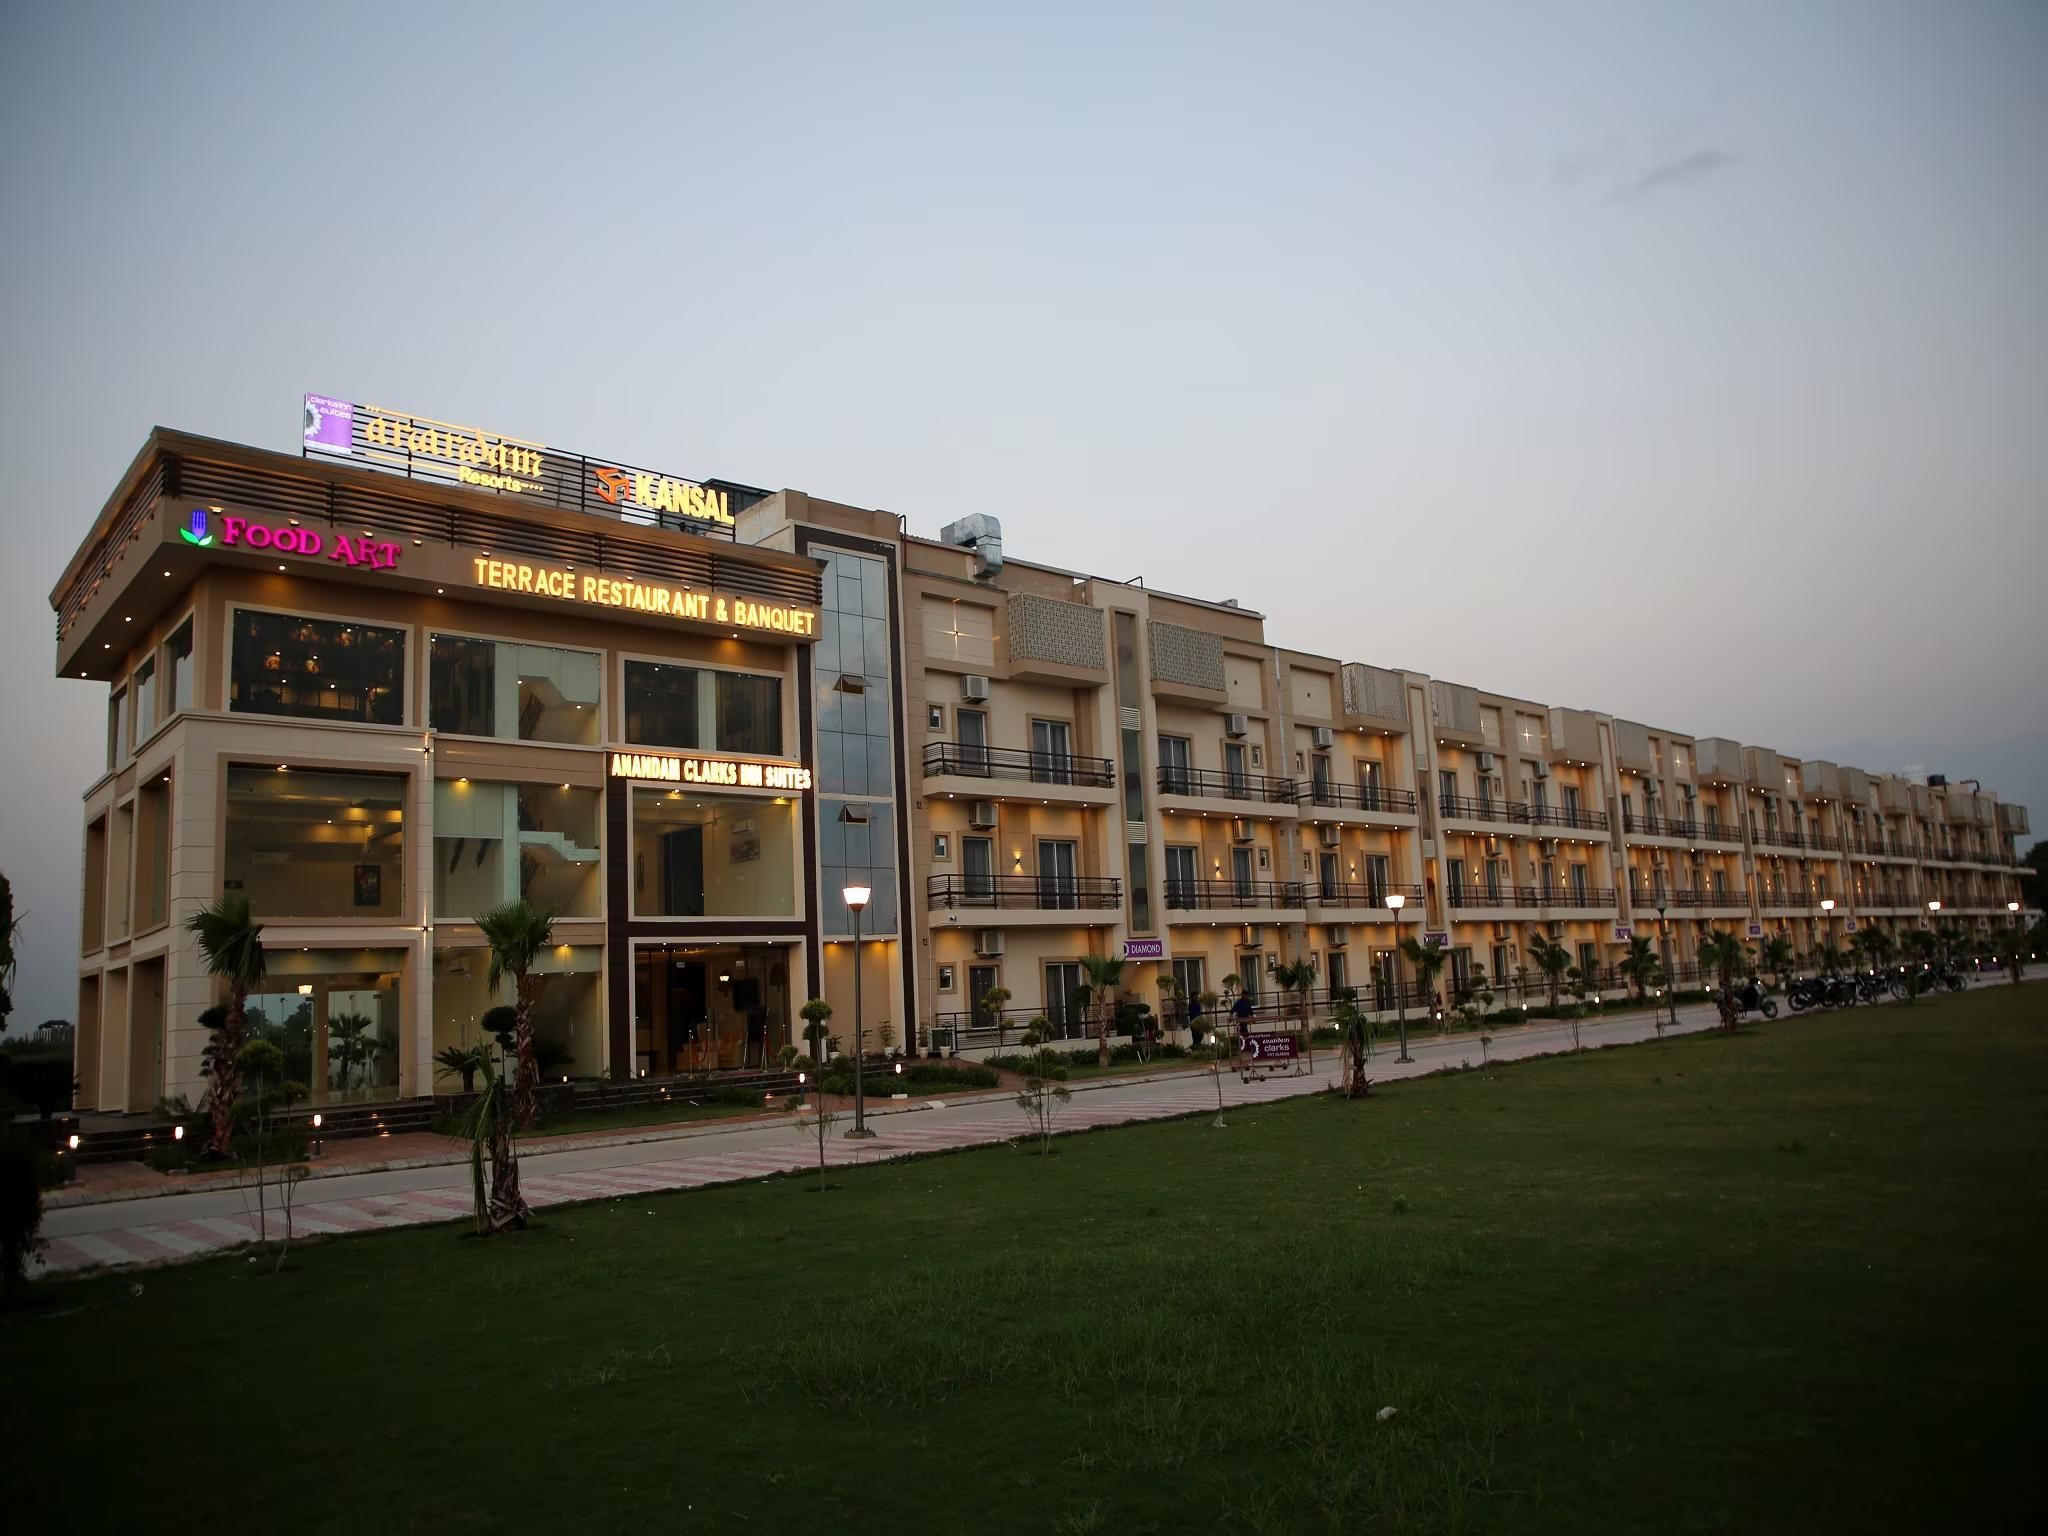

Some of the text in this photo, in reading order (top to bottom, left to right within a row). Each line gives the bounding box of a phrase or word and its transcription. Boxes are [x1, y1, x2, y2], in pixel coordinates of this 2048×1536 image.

[459, 466, 522, 492] Resorts
[635, 474, 735, 525] KANSAL
[221, 517, 400, 570] FOOD ART
[474, 558, 815, 635] TERRACE RESTAURANT & BANQUET
[611, 753, 812, 790] ANANDAM CLARKS INN SUITES
[1131, 944, 1160, 954] DIAMOND
